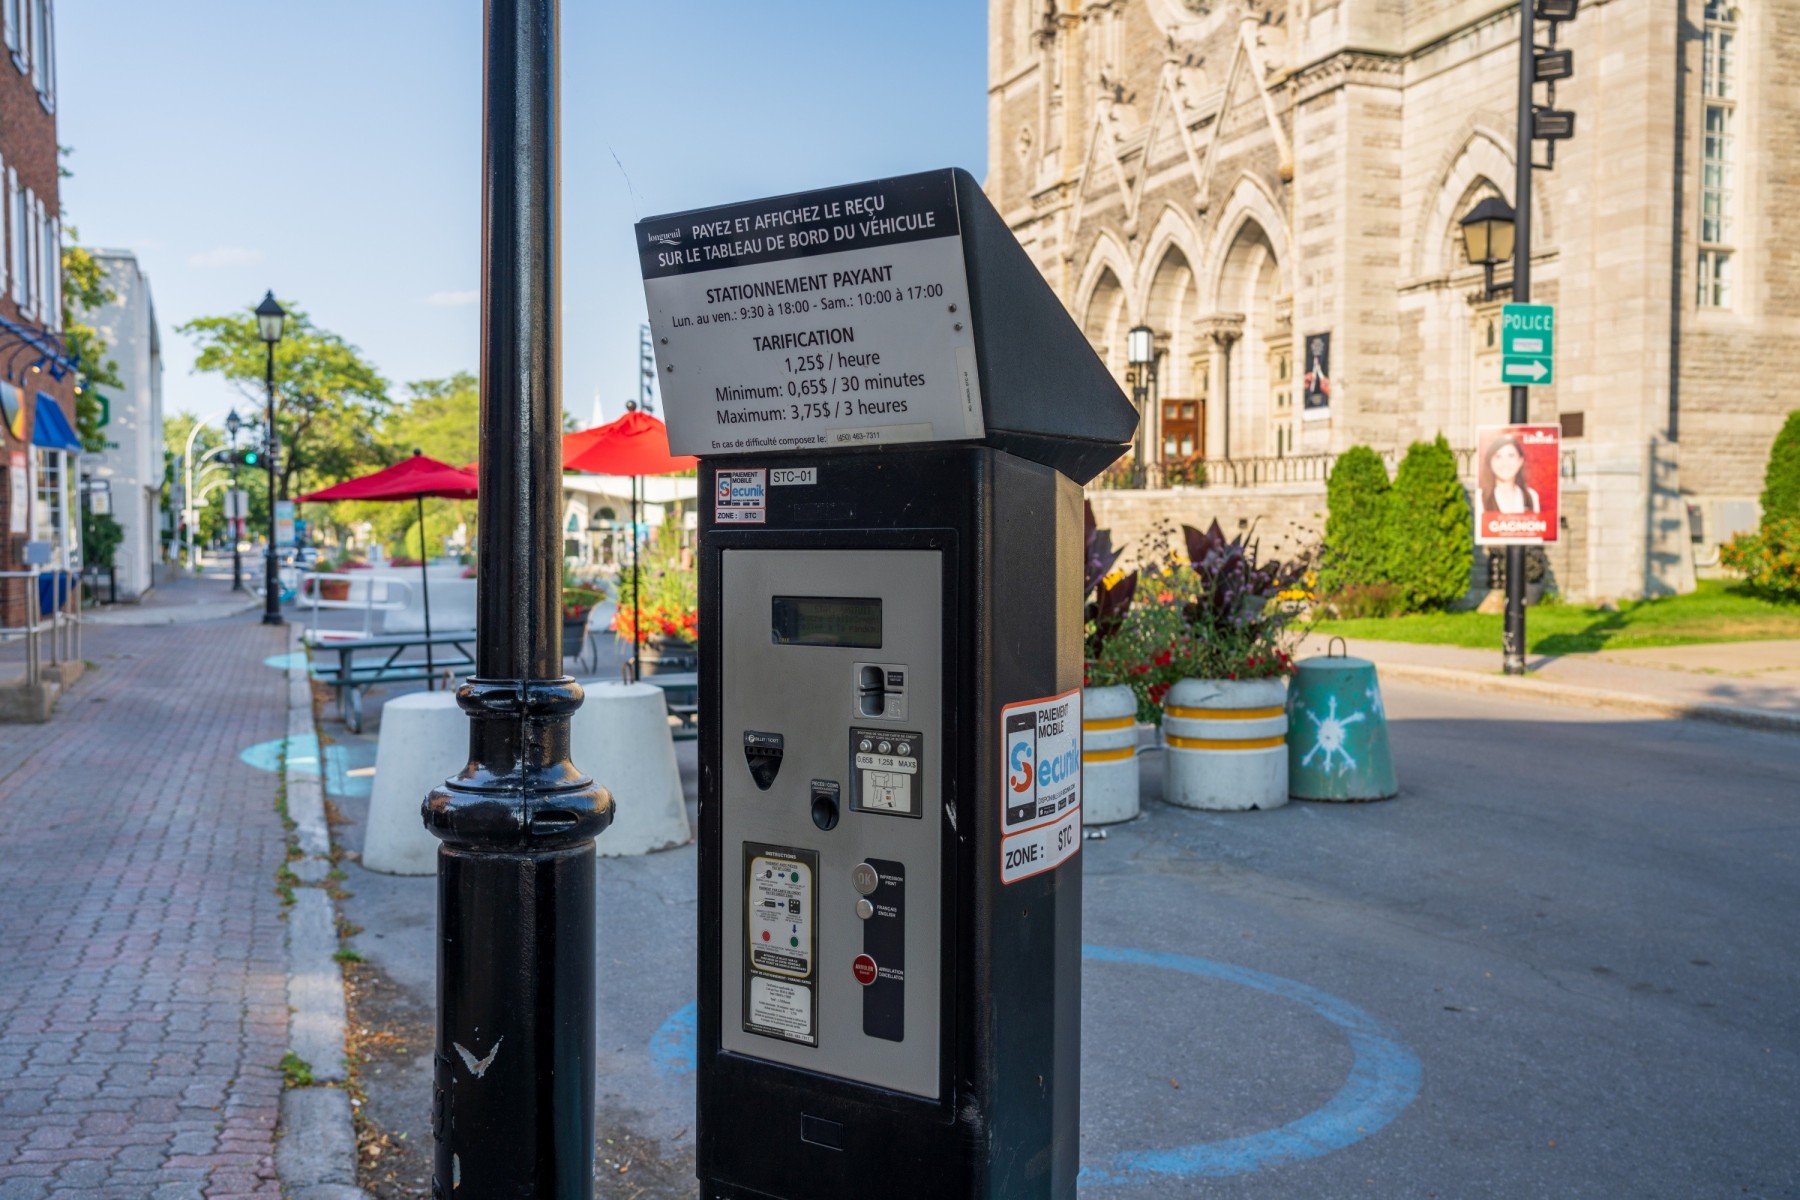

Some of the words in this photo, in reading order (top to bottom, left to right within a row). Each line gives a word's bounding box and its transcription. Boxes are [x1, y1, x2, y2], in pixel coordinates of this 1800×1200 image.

[692, 221, 732, 239] PAYEZ
[735, 217, 750, 233] ET
[755, 206, 820, 230] AFFICHEZ
[824, 202, 841, 219] LE
[845, 195, 885, 216] REÇU
[648, 228, 681, 242] longueuil
[658, 250, 683, 267] SUR
[686, 247, 701, 263] LE
[703, 239, 762, 260] TABLEAU
[766, 235, 785, 251] DE
[789, 229, 829, 248] BORD
[833, 224, 855, 241] DU
[859, 211, 936, 237] VÉHICULE
[706, 274, 828, 304] STATIONNEMENT
[833, 265, 893, 288] PAYANT
[672, 316, 694, 328] Lun.
[697, 315, 709, 325] au
[712, 311, 738, 323] ven.:
[740, 305, 765, 320] 9:30
[768, 304, 775, 317] à
[777, 300, 810, 316] 18:00
[820, 297, 854, 311] Sam.:
[857, 290, 892, 306] 10:00
[896, 288, 904, 302] à
[907, 283, 943, 300] 17:00
[1503, 314, 1553, 330] POLICE
[753, 327, 855, 352] TARIFICATION
[785, 354, 825, 374] 1,25$
[829, 353, 834, 371] /
[838, 352, 881, 368] heure
[715, 385, 783, 402] Minimum:
[788, 378, 828, 398] 0,65$
[831, 378, 837, 395] /
[841, 376, 860, 392] 30
[864, 372, 926, 390] minutes
[716, 409, 787, 425] Maximum:
[790, 401, 831, 421] 3,75$
[834, 401, 840, 418] /
[844, 401, 853, 416] 3
[858, 399, 908, 415] heures
[711, 440, 721, 449] En
[735, 439, 744, 447] de
[745, 437, 777, 447] difficulté
[778, 436, 815, 445] composez
[817, 434, 827, 443] le:
[836, 432, 851, 442] (450)
[852, 431, 880, 440] 463-7311
[773, 470, 812, 483] STC-01
[1488, 520, 1547, 532] GAGNON
[1038, 703, 1068, 723] PAIEMENT
[1038, 720, 1064, 739] MOBILE
[857, 756, 873, 765] 0,65$
[878, 758, 893, 767] 1,25$
[898, 760, 916, 769] MAX$
[1005, 844, 1038, 870] ZONE
[1058, 824, 1072, 851] STC
[858, 873, 871, 885] OK
[878, 966, 904, 975] ANNULATION
[878, 972, 904, 980] CANCELLATION
